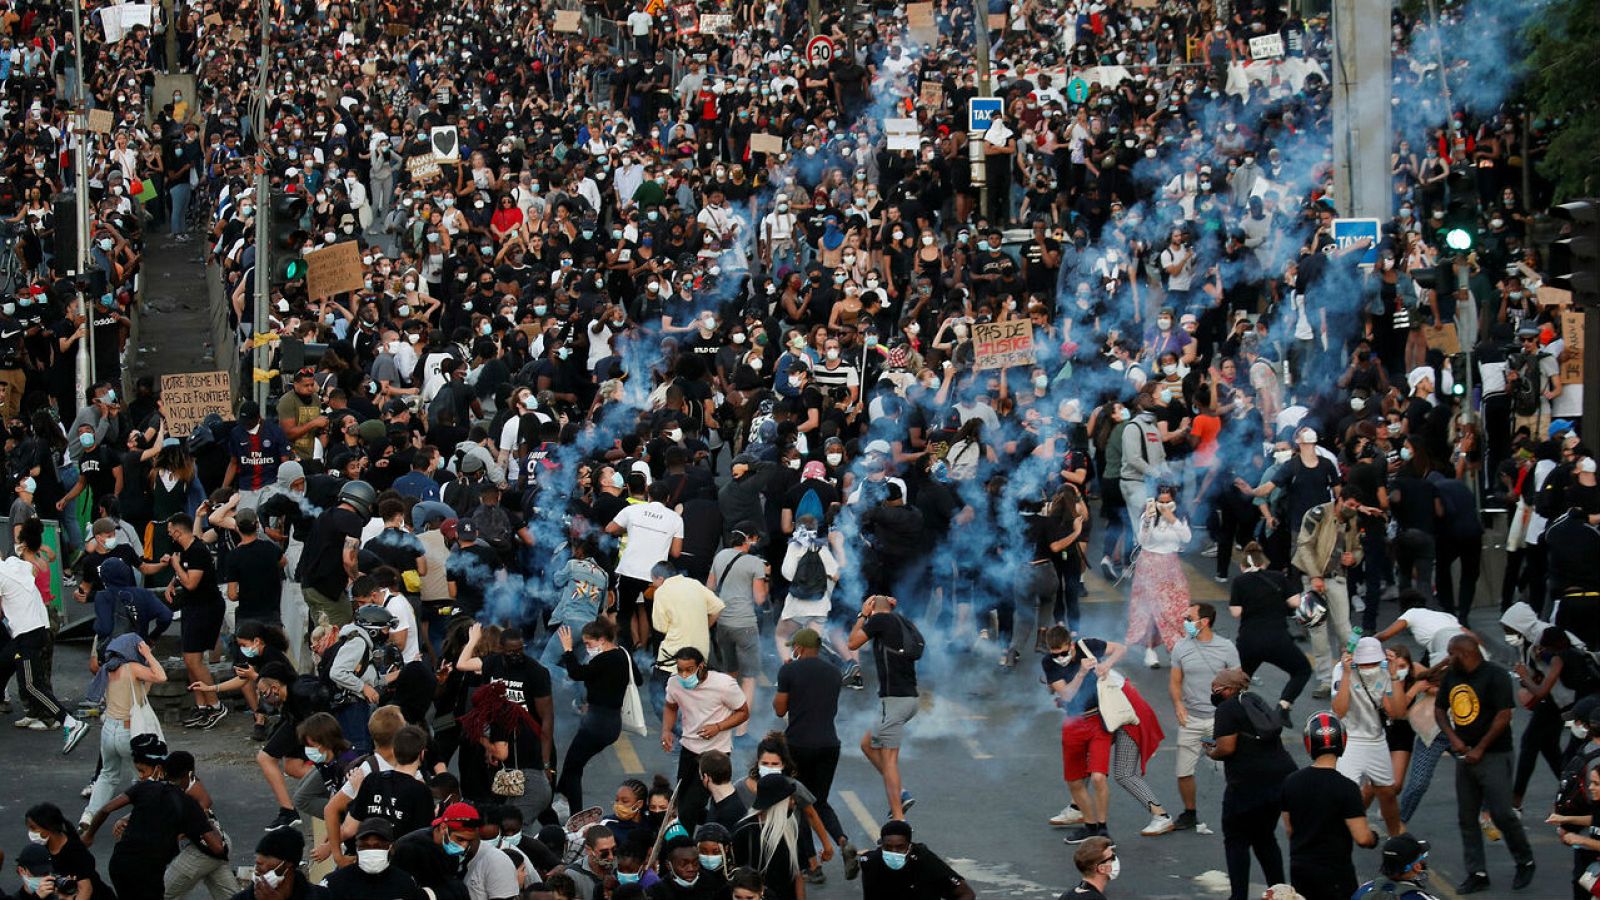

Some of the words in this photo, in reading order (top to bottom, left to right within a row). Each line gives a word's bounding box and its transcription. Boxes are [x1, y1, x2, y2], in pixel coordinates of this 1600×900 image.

[975, 324, 1002, 343] PAS
[1005, 322, 1025, 339] DE
[976, 336, 1031, 357] JUSTICE
[162, 376, 185, 390] VOTRE
[164, 392, 182, 405] PAS
[183, 392, 192, 404] DE
[241, 456, 274, 465] Emirates
